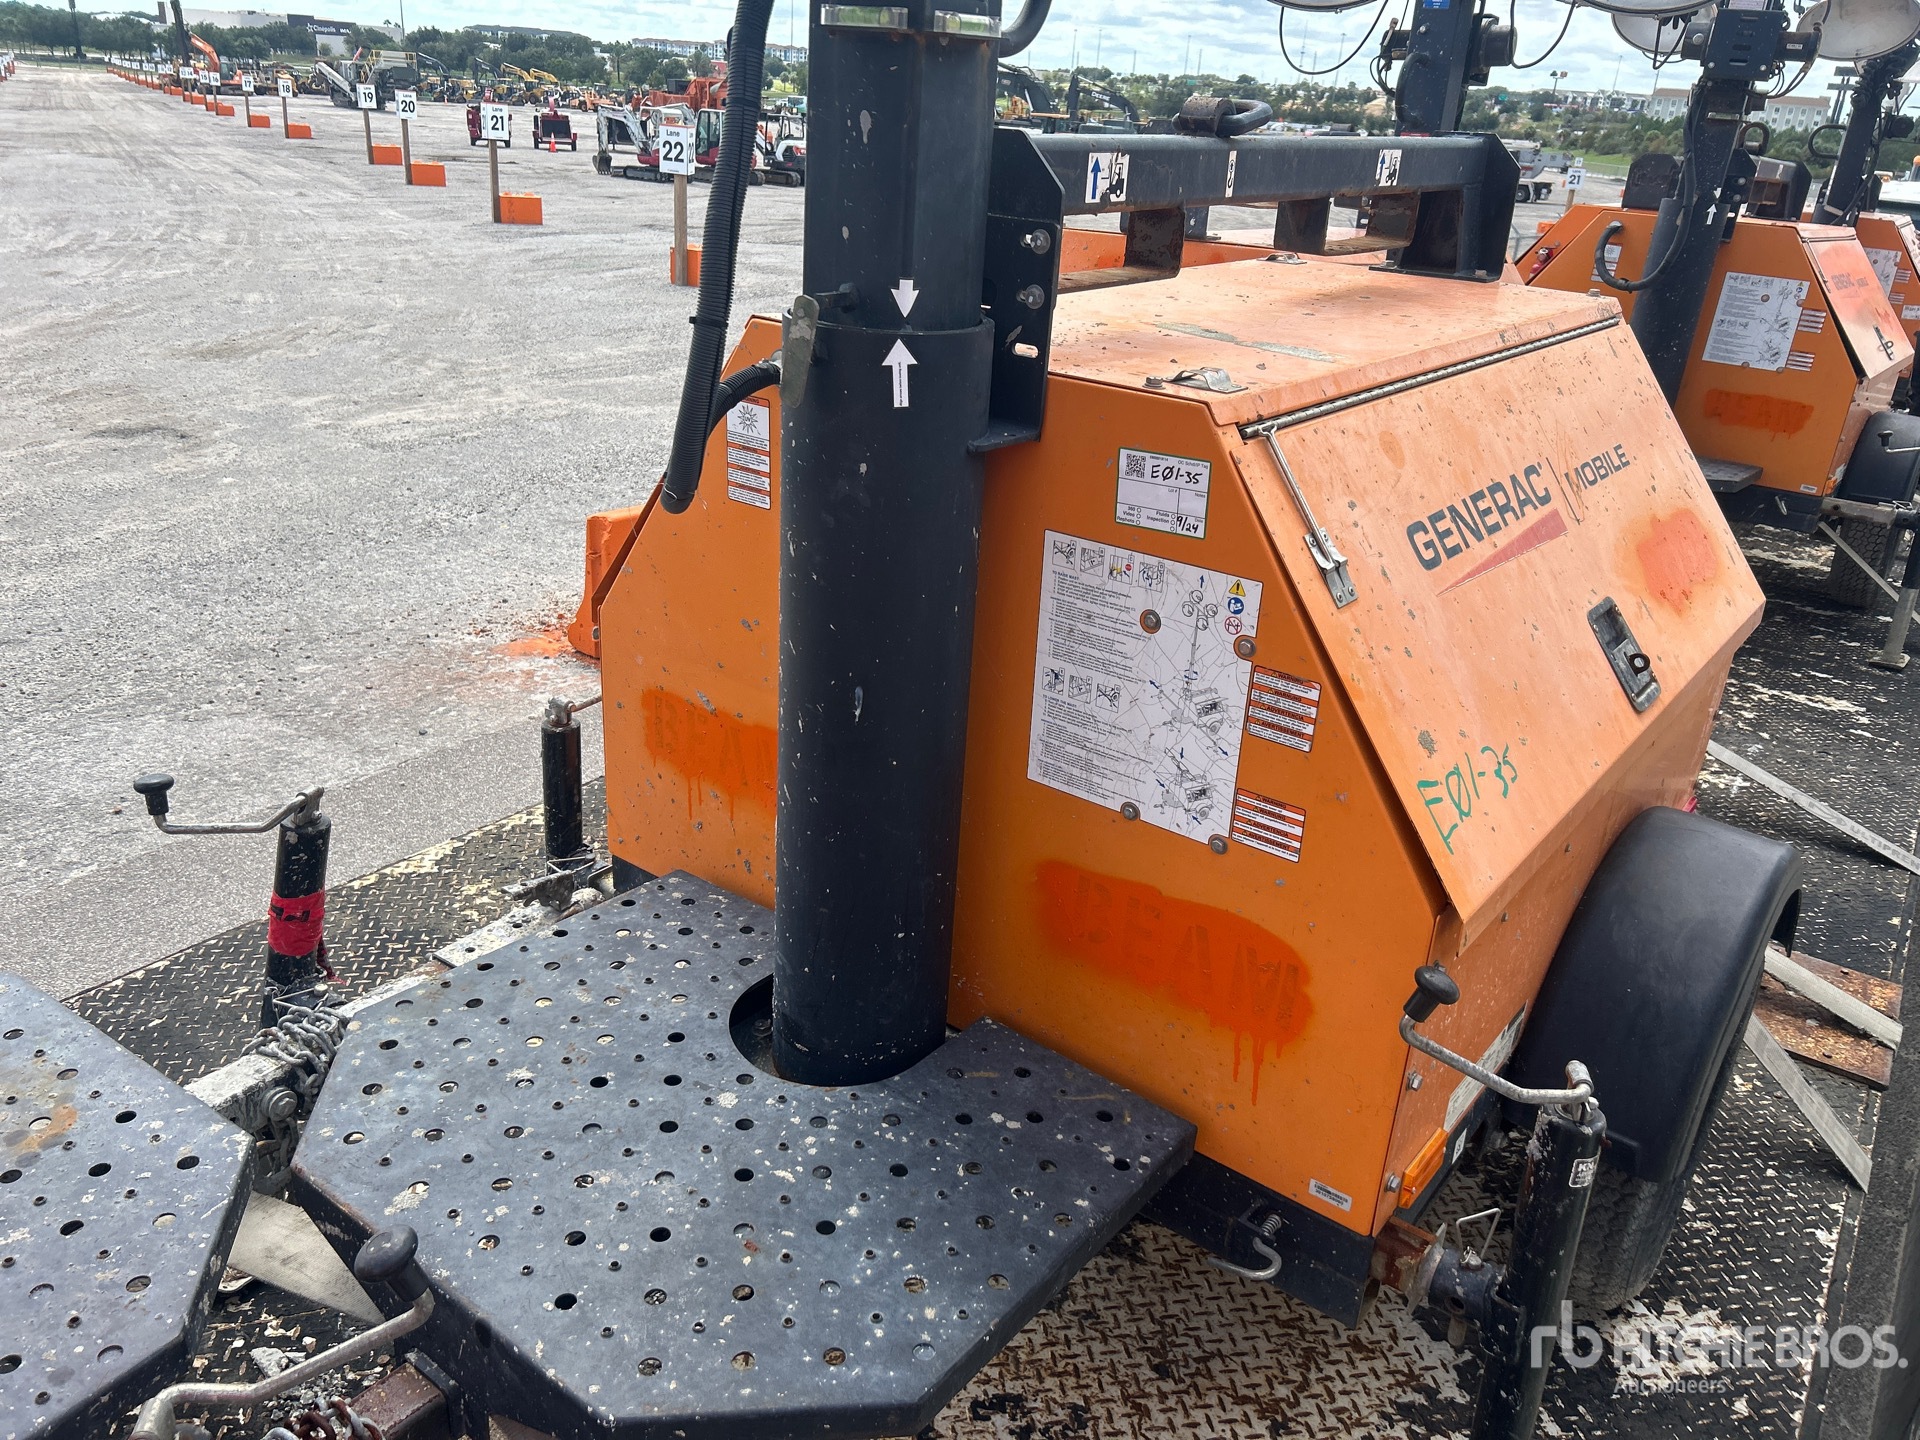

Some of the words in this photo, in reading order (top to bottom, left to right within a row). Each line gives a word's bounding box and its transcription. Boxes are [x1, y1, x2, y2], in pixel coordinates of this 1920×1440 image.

[282, 84, 291, 93] 18
[363, 92, 373, 103] 19
[401, 100, 415, 113] 20
[490, 115, 505, 131] 21
[662, 140, 684, 163] 22
[1568, 174, 1581, 185] 21
[1406, 464, 1551, 571] GENERAC
[1564, 444, 1630, 490] MOBILE
[1147, 515, 1169, 523] Inspection
[1176, 516, 1199, 534] 9/24
[1267, 705, 1304, 720] ADVERTENCIA
[1252, 821, 1288, 838] ADVERTENCIA
